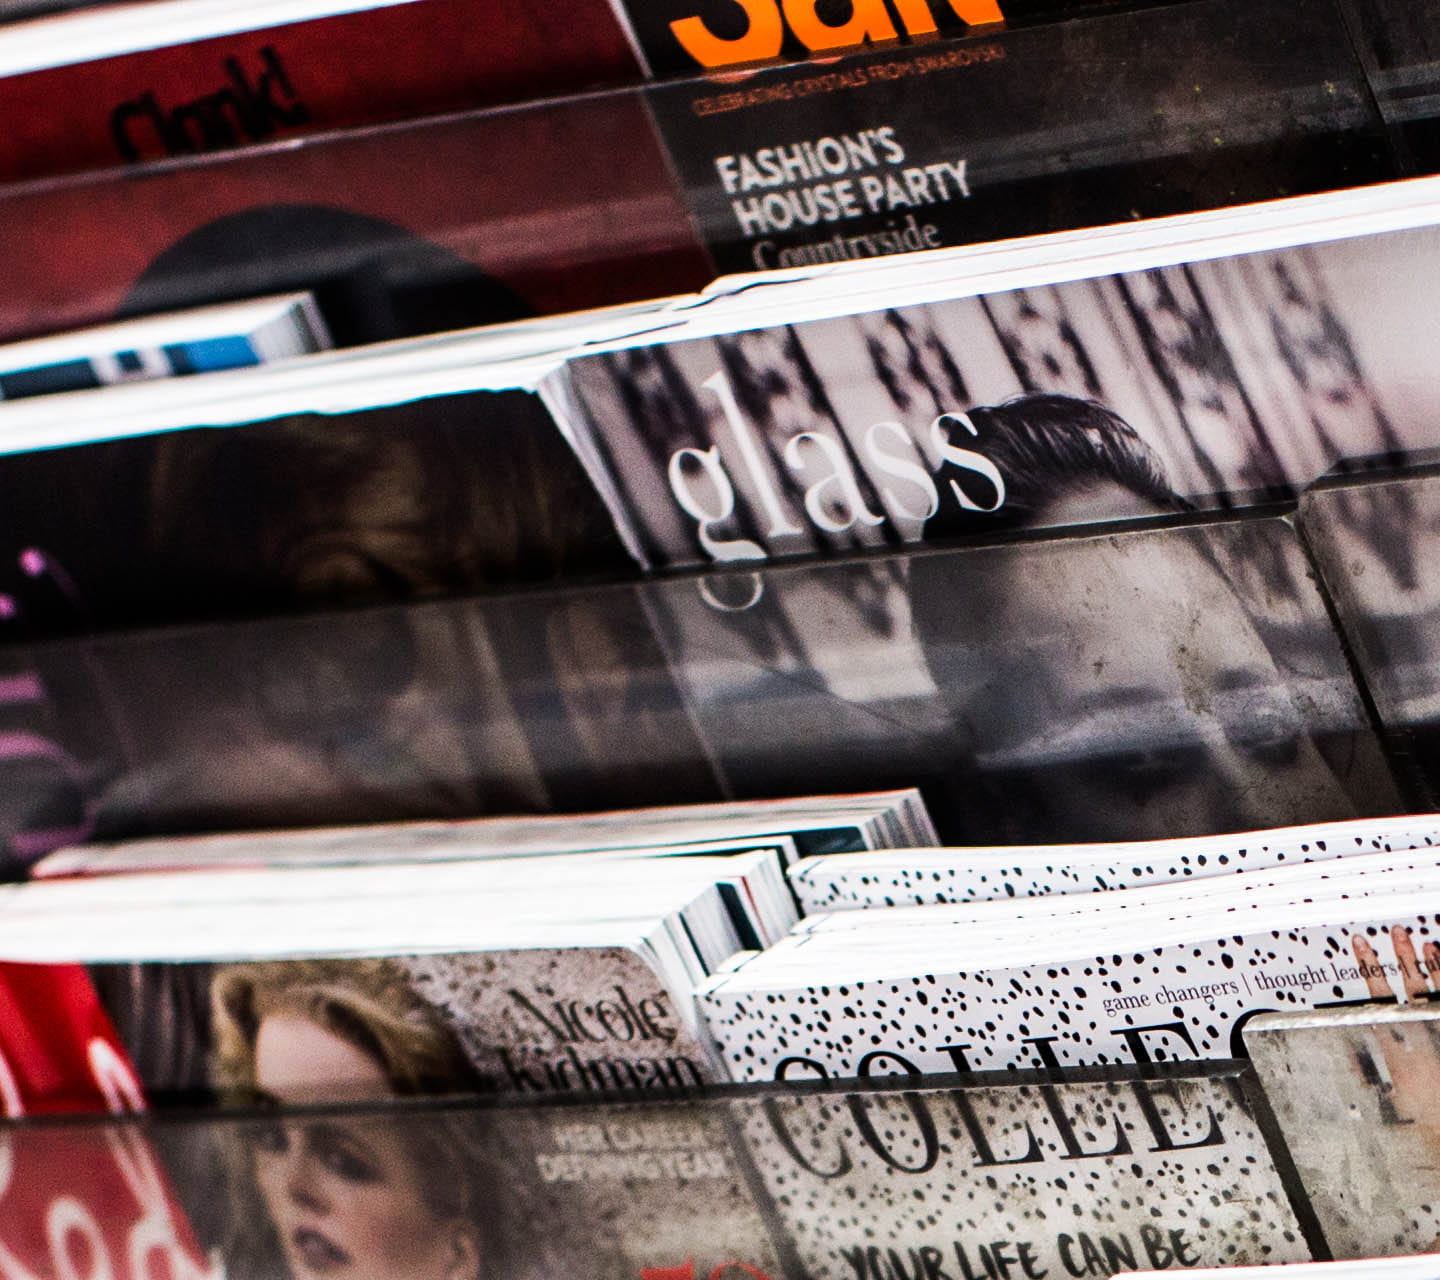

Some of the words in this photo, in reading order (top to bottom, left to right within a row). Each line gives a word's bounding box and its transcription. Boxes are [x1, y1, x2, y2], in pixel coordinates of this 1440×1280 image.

[714, 126, 906, 194] FASHION'S
[731, 180, 864, 238] HOUSE
[859, 159, 972, 214] PARTY
[667, 373, 1006, 610] glass
[1102, 992, 1150, 1018] game
[1155, 976, 1240, 1013] changers
[1253, 960, 1329, 997] thought
[1331, 952, 1400, 984] leaders
[1058, 1231, 1140, 1279] CAN
[1139, 1222, 1202, 1271] BE
